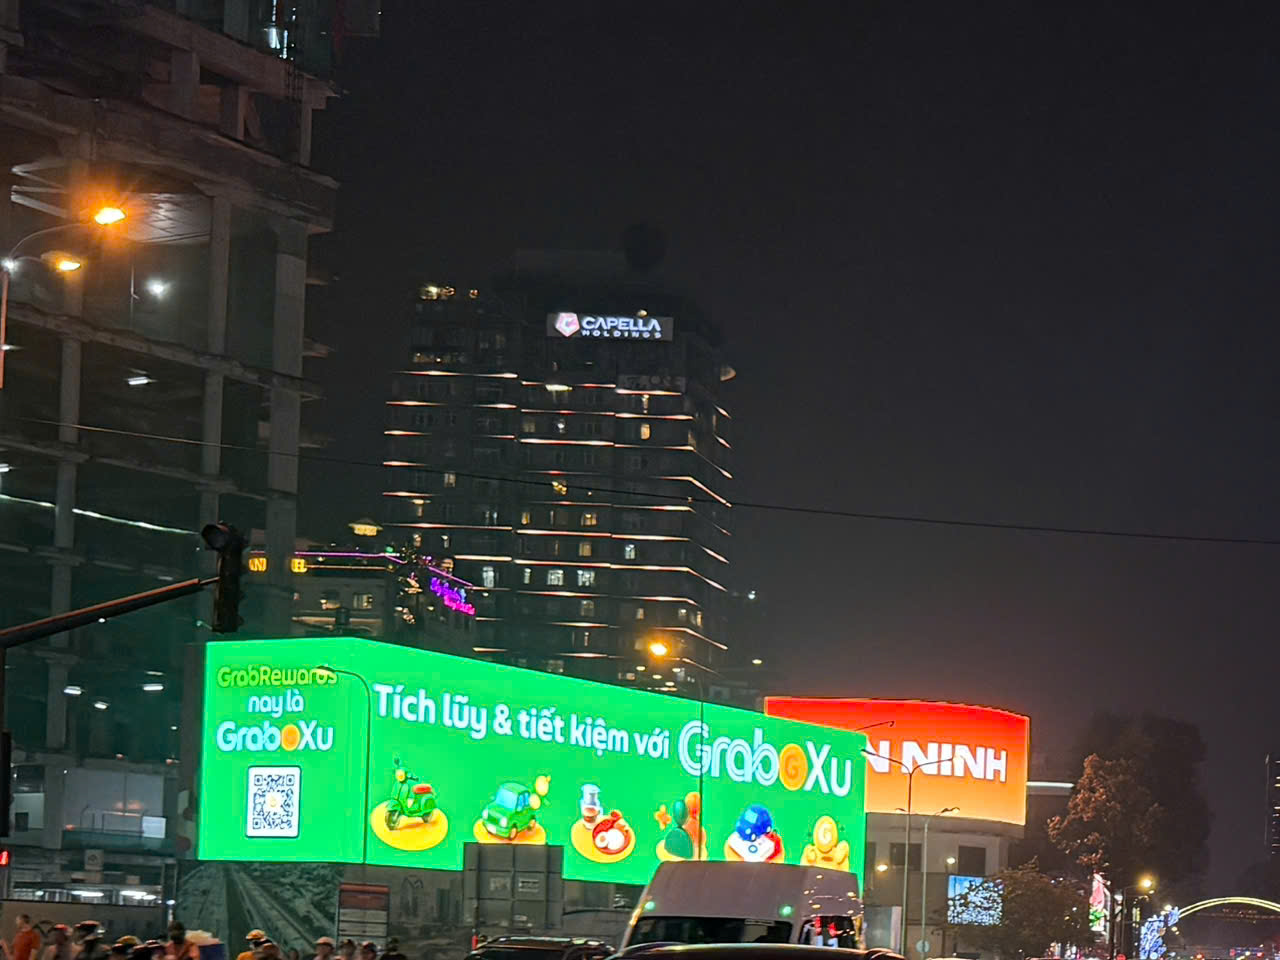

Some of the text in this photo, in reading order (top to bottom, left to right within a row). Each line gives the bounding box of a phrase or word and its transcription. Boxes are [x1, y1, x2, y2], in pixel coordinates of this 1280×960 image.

[581, 316, 661, 332] CAPELLA
[581, 329, 662, 339] HOLDINGS
[217, 664, 338, 688] GrabRewards
[247, 688, 305, 719] nay là
[374, 683, 436, 724] Tích
[443, 693, 488, 740] lũy
[493, 704, 513, 736] &
[519, 707, 565, 743] tiết
[570, 714, 629, 757] kiệm
[634, 727, 669, 759] với
[901, 740, 1007, 783] NINH
